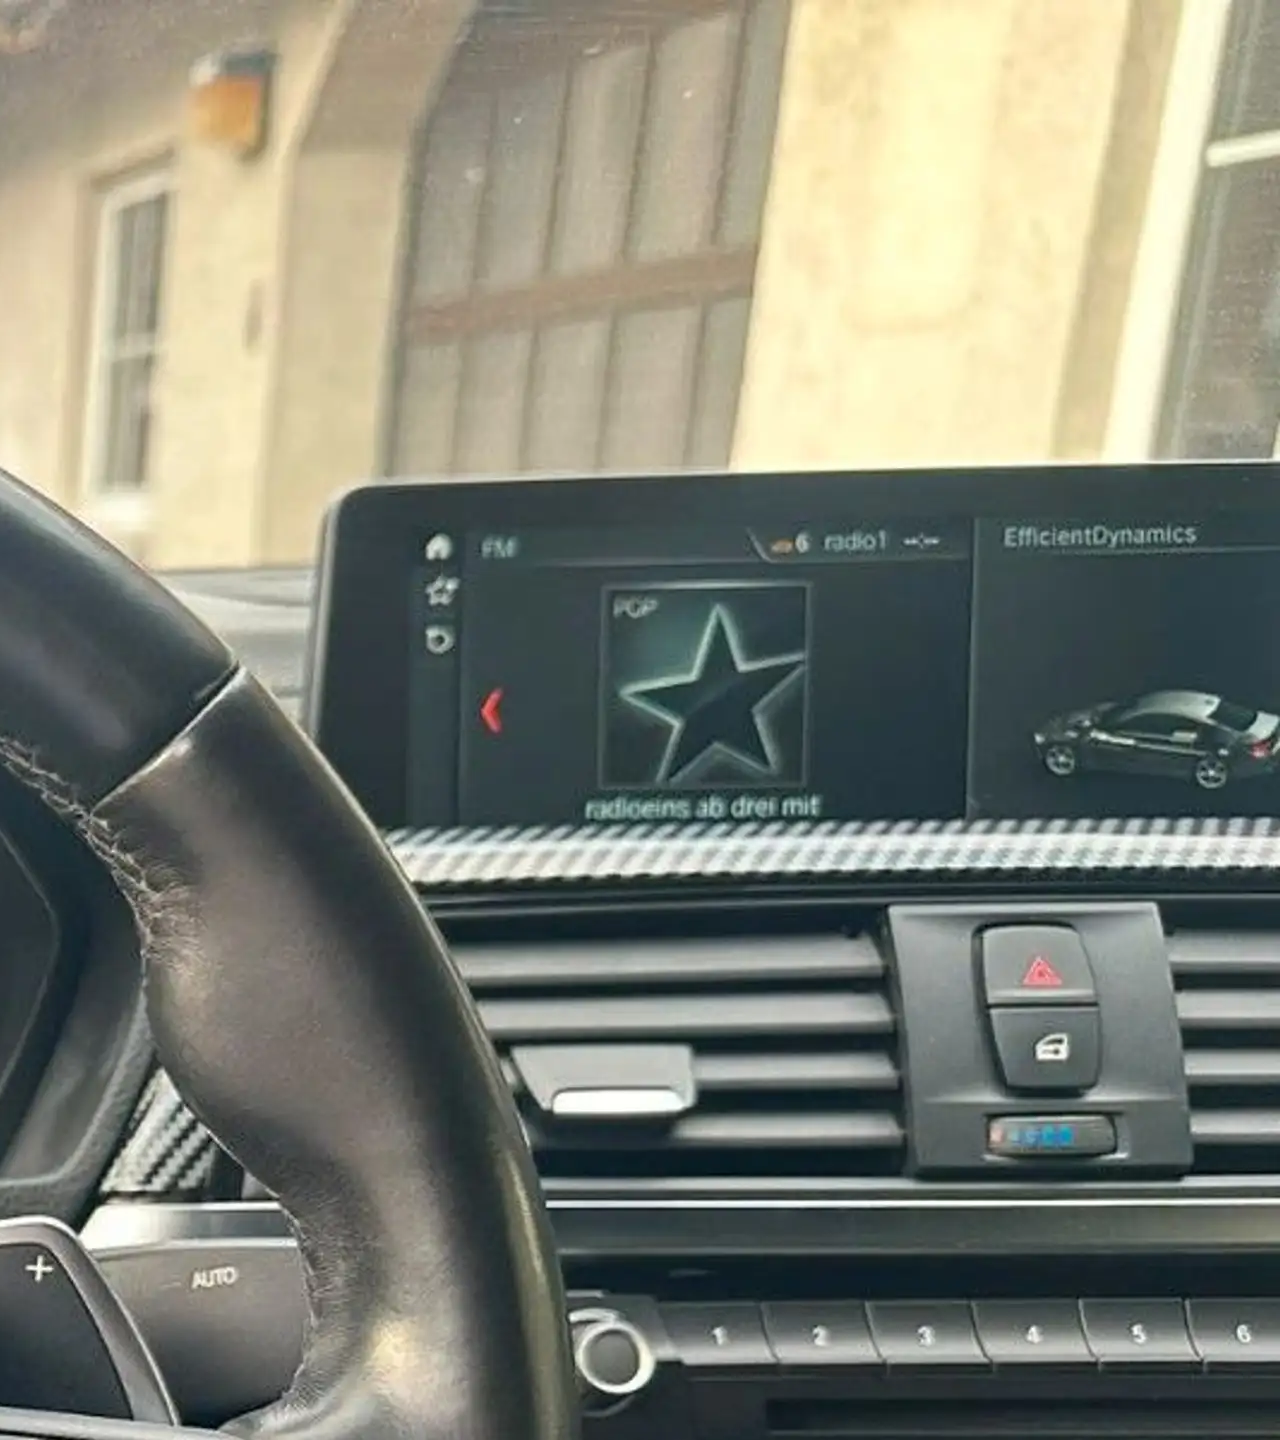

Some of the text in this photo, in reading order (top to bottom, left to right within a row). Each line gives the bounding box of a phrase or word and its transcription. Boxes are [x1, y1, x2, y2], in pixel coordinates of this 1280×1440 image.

[824, 529, 886, 551] radio1
[1004, 524, 1198, 548] EfficientDynamics
[585, 793, 822, 820] radioeins ab drei mit
[191, 1266, 239, 1290] AUTO
[712, 1325, 727, 1346] 1
[812, 1325, 829, 1346] 2
[917, 1325, 935, 1346] 3
[1023, 1325, 1042, 1345] 4
[1130, 1323, 1148, 1345] 5
[1236, 1323, 1252, 1345] 6
